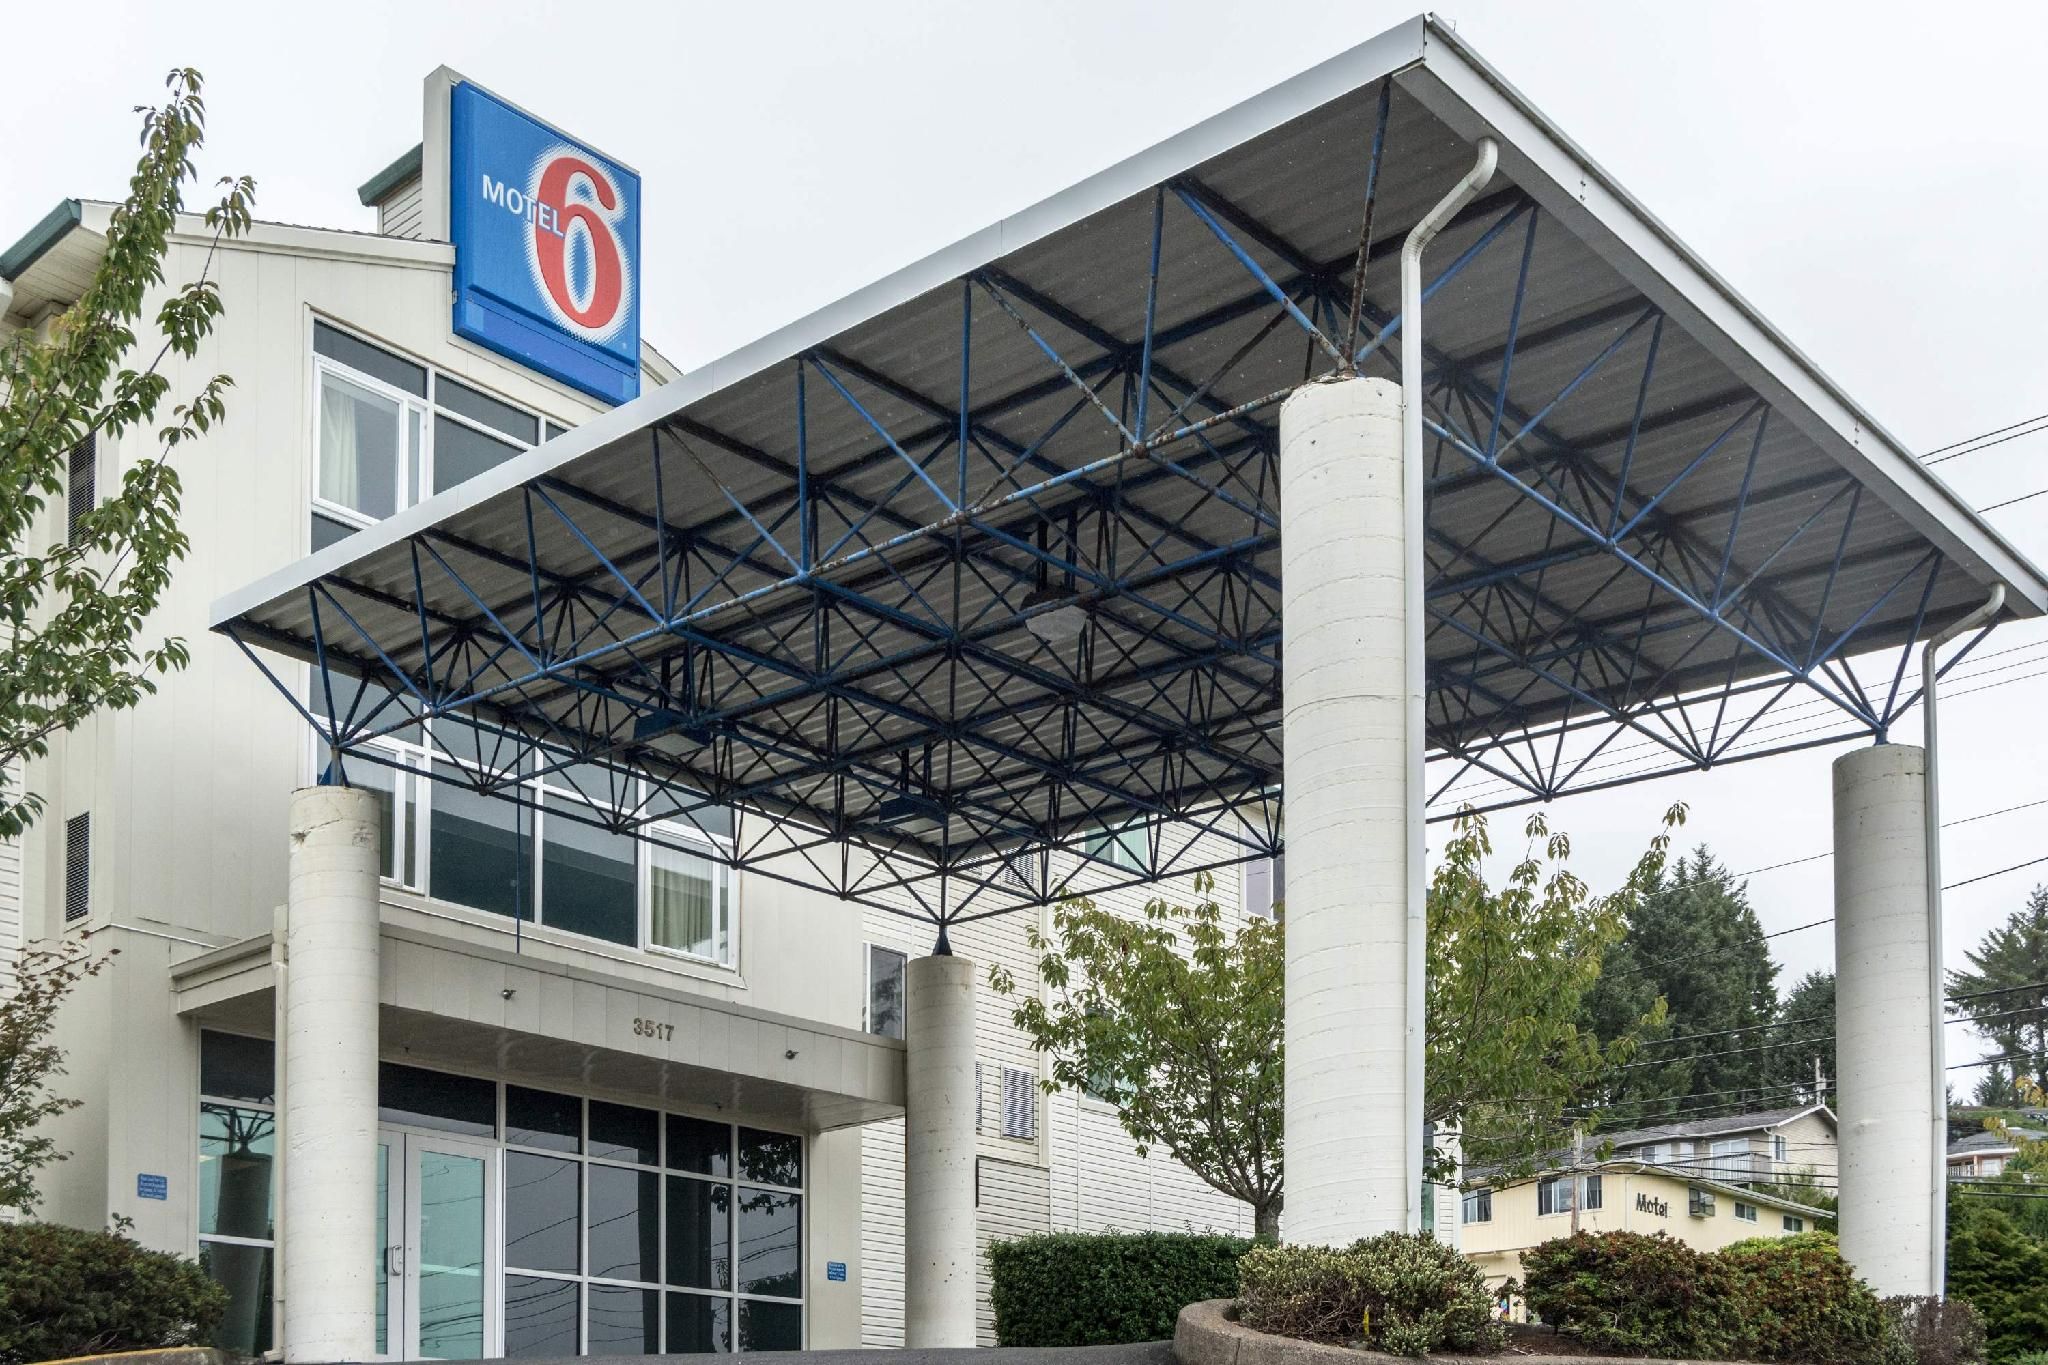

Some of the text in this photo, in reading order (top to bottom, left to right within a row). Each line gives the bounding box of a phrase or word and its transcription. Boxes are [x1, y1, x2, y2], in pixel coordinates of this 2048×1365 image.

[482, 156, 622, 329] MOTEL 6
[633, 1017, 675, 1042] 3517
[1636, 1192, 1668, 1218] Motel
